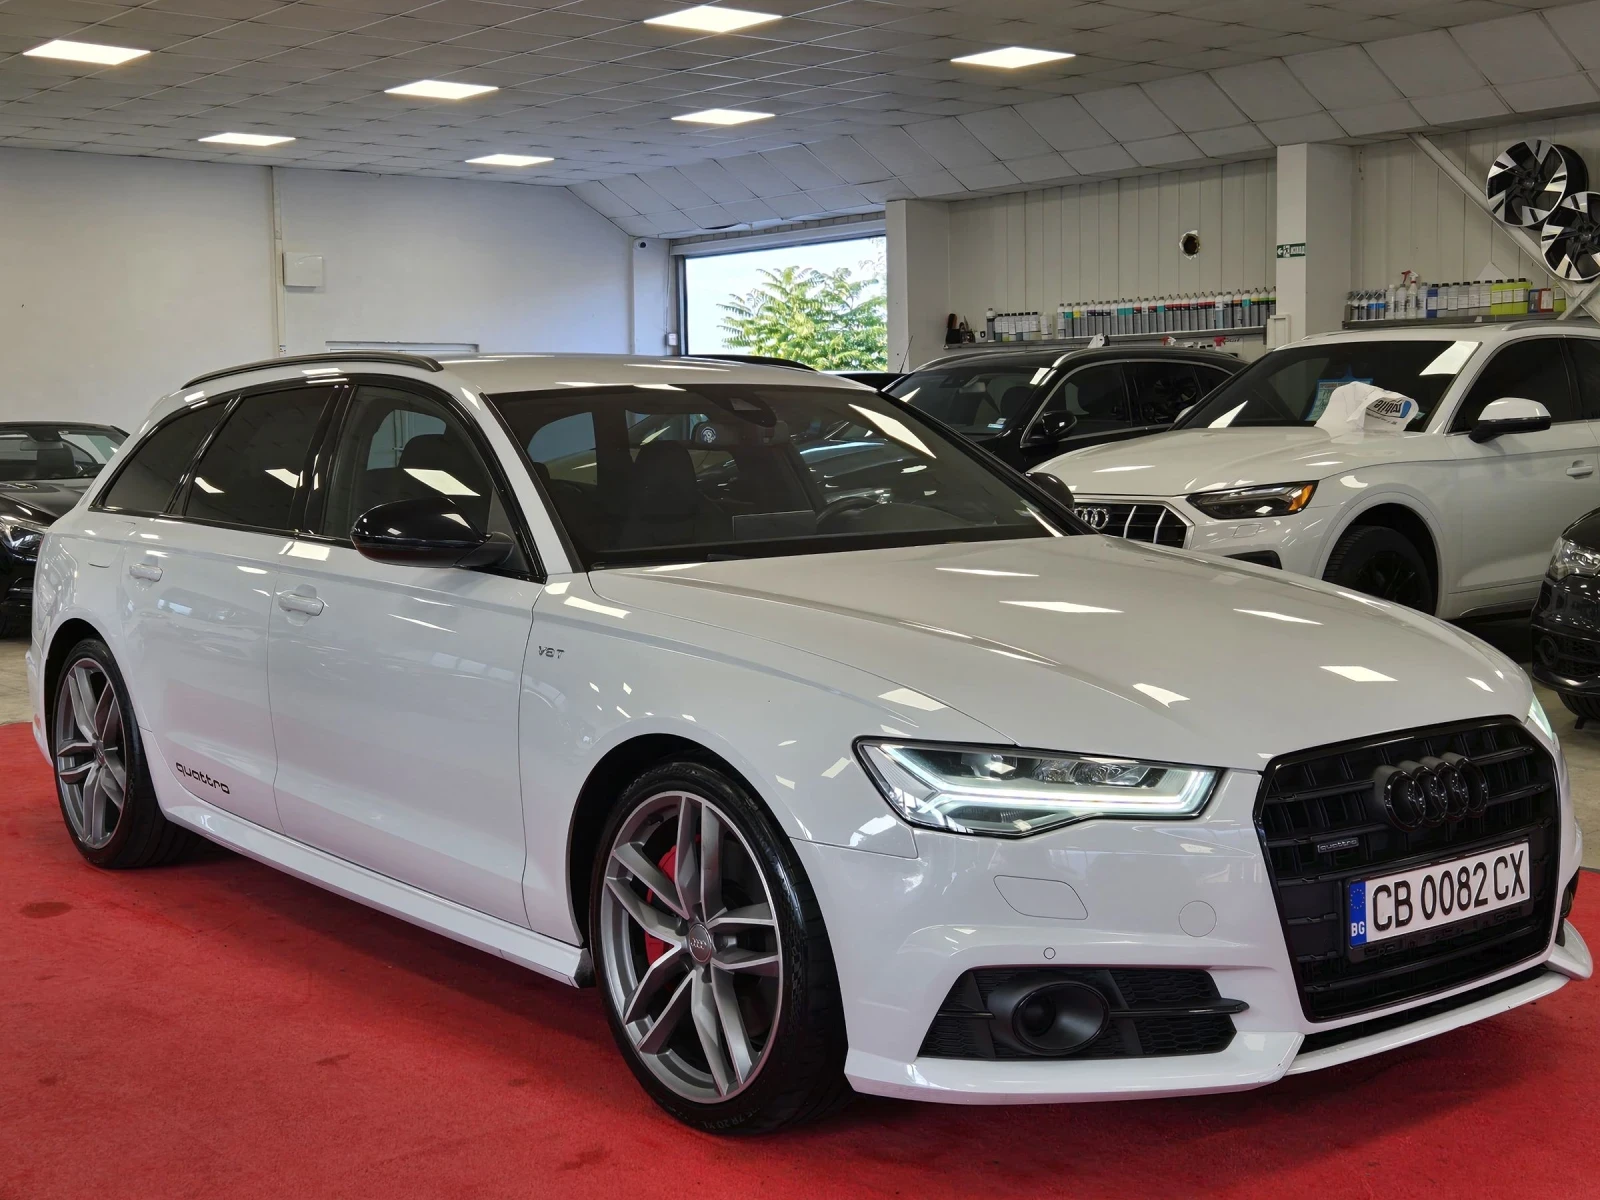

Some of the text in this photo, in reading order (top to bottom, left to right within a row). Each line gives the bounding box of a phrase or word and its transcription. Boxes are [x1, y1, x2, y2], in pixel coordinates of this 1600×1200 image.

[175, 762, 231, 795] quattro
[1319, 839, 1357, 851] quattro
[1372, 850, 1526, 932] CB 0082 CX
[1351, 922, 1365, 937] BG
